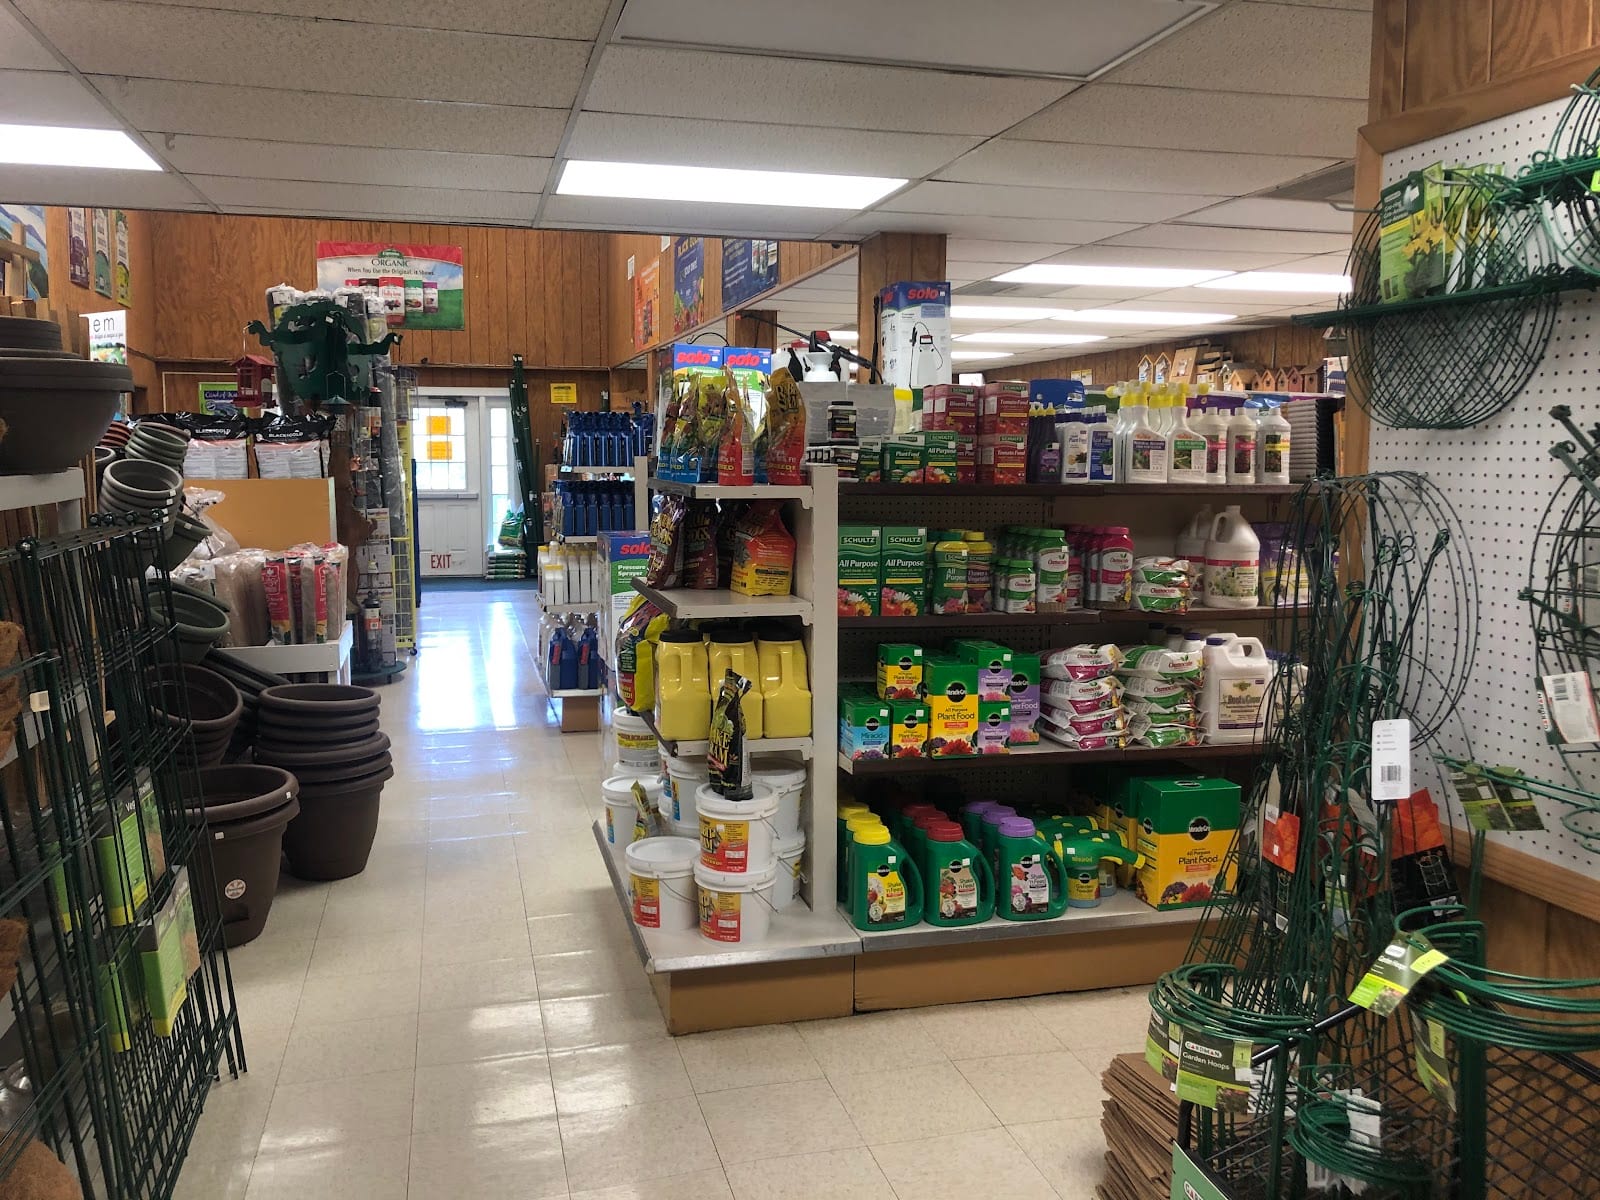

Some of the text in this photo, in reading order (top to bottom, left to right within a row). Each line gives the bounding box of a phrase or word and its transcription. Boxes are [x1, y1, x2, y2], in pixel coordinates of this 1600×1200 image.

[371, 258, 408, 267] ORGANIC
[907, 287, 939, 300] solo
[677, 349, 711, 365] solo
[727, 352, 760, 367] solo
[620, 542, 652, 556] solo
[431, 554, 452, 569] EXIT
[839, 559, 879, 569] All Purpose
[885, 559, 925, 568] All Purpose
[617, 570, 643, 578] Sprayer
[1021, 702, 1038, 710] Food
[937, 712, 975, 721] Plant Food
[1178, 855, 1218, 865] Plant Food
[1182, 1051, 1230, 1070] Garden Hoops
